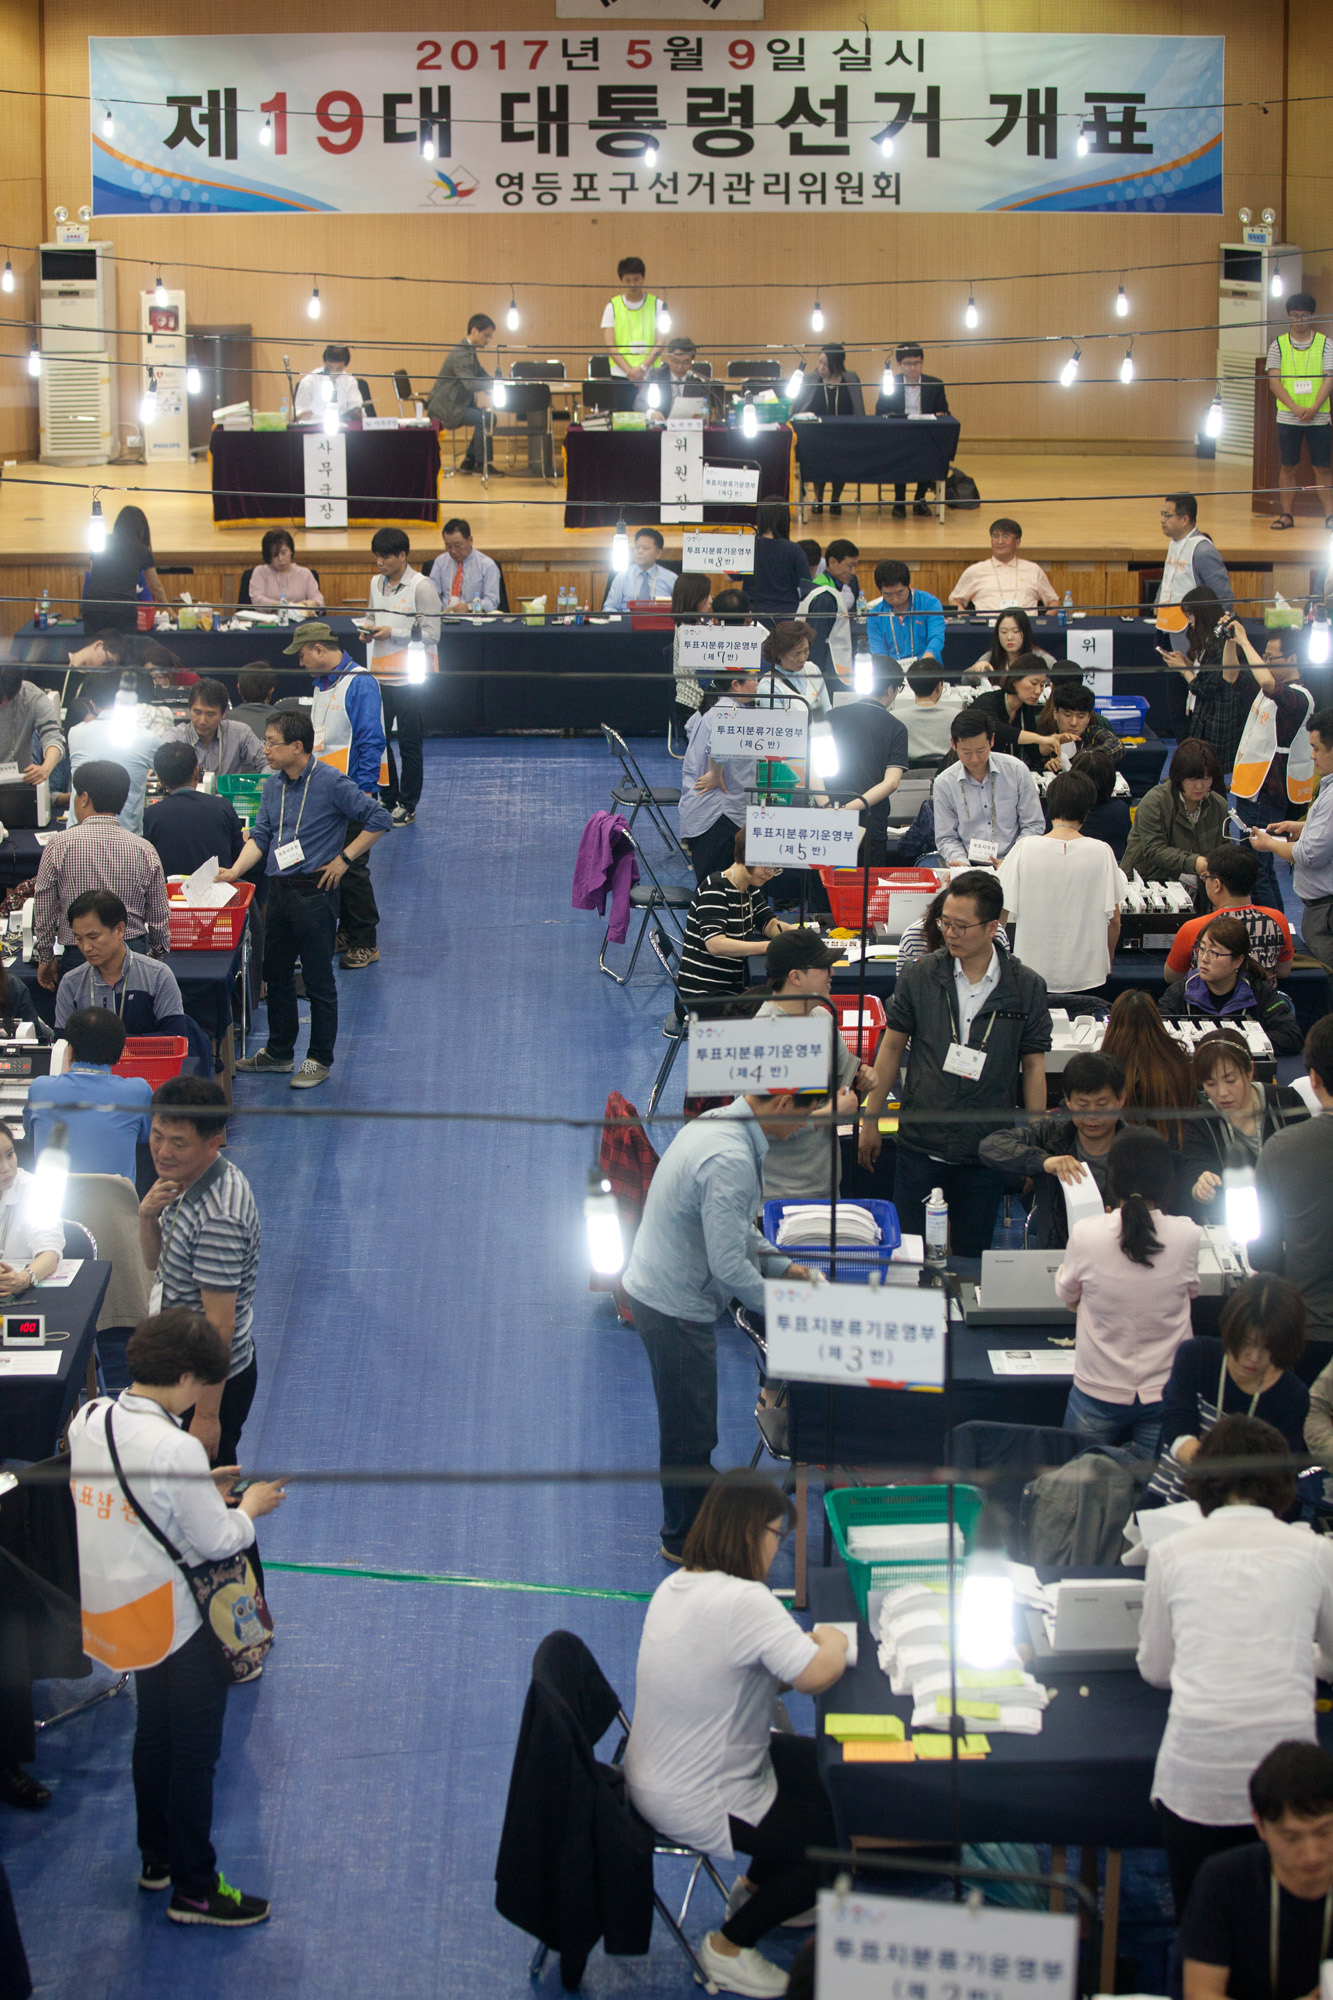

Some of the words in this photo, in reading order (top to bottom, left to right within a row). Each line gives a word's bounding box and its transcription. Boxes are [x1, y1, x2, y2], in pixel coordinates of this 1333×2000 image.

[417, 36, 600, 72] 2017년
[627, 36, 704, 72] 5월
[729, 37, 806, 72] 9일
[832, 36, 925, 72] 실시
[163, 85, 452, 160] 제19대
[501, 84, 940, 160] 대통령선거
[985, 86, 1154, 160] 개표
[496, 172, 901, 206] 영등포구선거관리위원회
[318, 440, 334, 520] 사무국장
[674, 437, 690, 511] 위원장
[686, 546, 752, 556] 투표지분류기운영부
[683, 640, 759, 651] 투표지분류기운영부
[716, 725, 804, 738] 투표지분류기운영부
[752, 827, 854, 842] 투표지분류기운영부
[695, 1043, 823, 1061] 투표지분류기운영부
[20, 1322, 37, 1333] 100
[776, 1314, 937, 1342] 투표지분류기운영부
